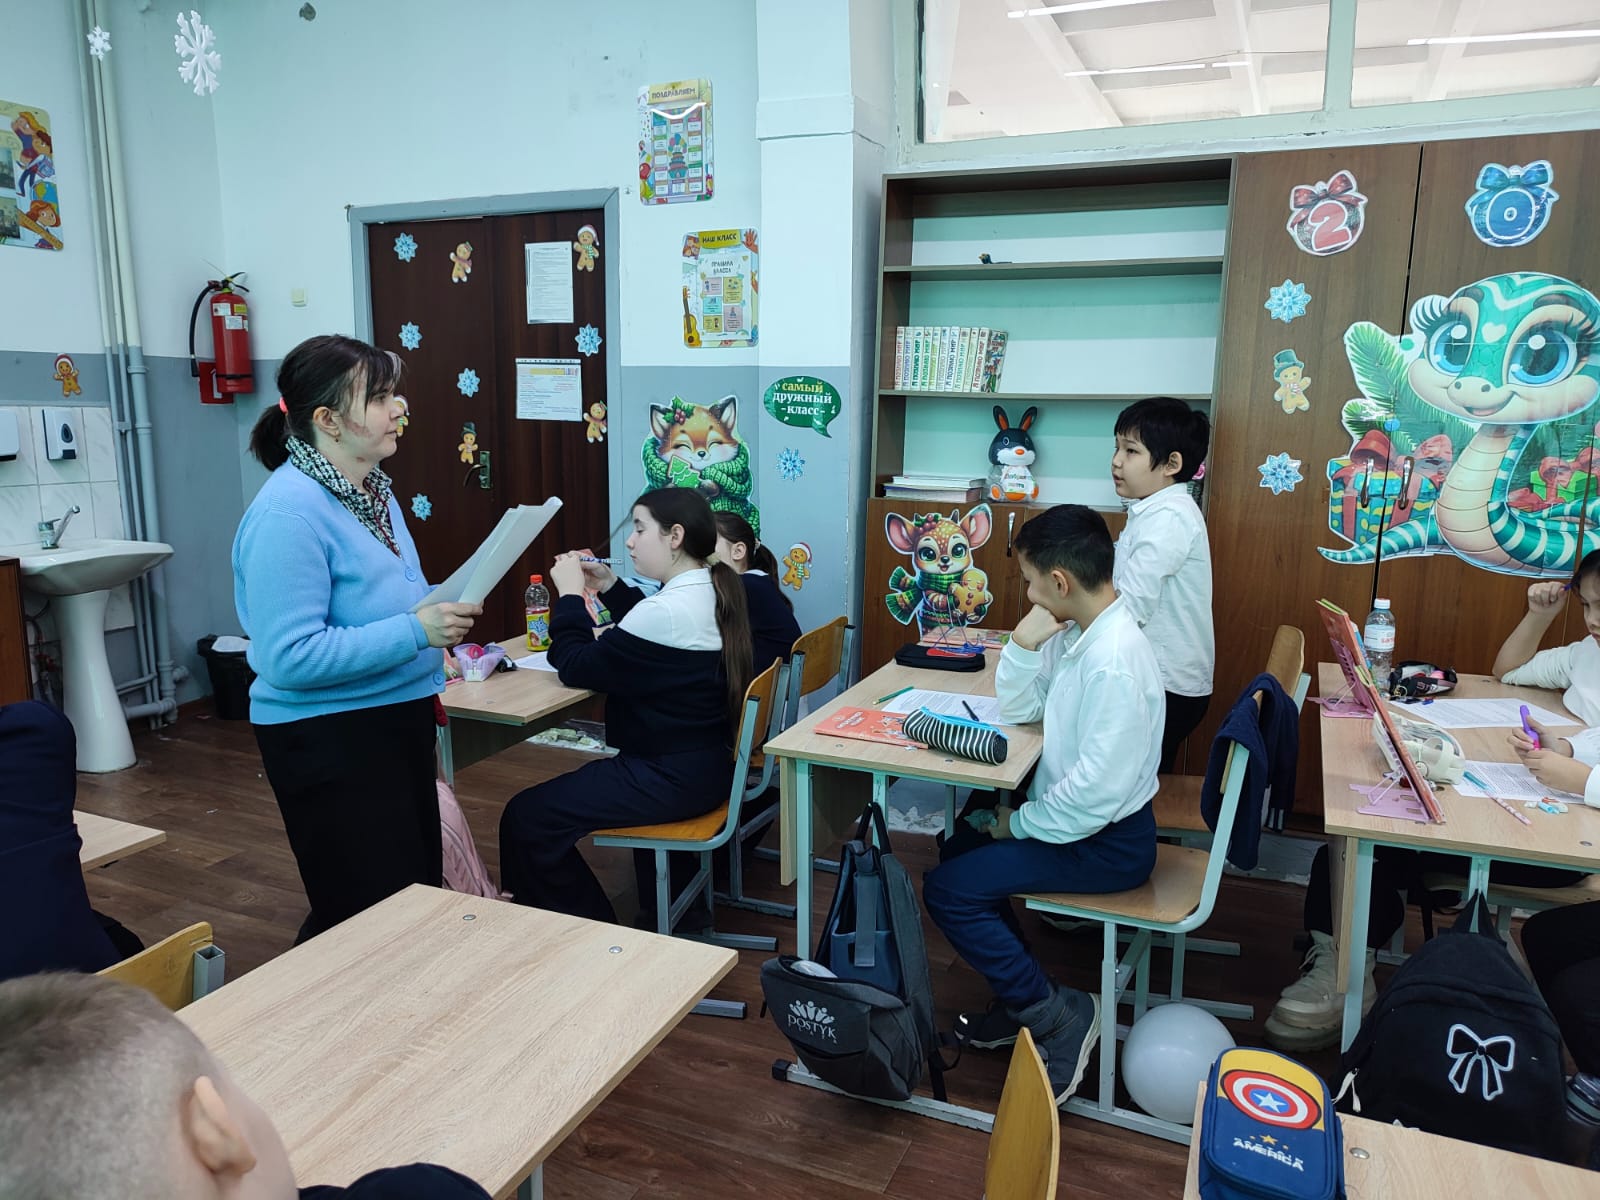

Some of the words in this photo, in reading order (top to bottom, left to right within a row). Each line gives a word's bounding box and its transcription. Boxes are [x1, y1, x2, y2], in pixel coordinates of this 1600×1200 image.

[652, 88, 695, 99] ПОЗДРАВЛЯЕМ
[1308, 200, 1351, 251] 2
[1486, 188, 1535, 240] 0
[702, 235, 716, 243] НАШ
[717, 233, 737, 241] КЛАСС
[782, 381, 824, 393] самый
[773, 392, 833, 404] дружный
[788, 1014, 837, 1039] DOSTYK
